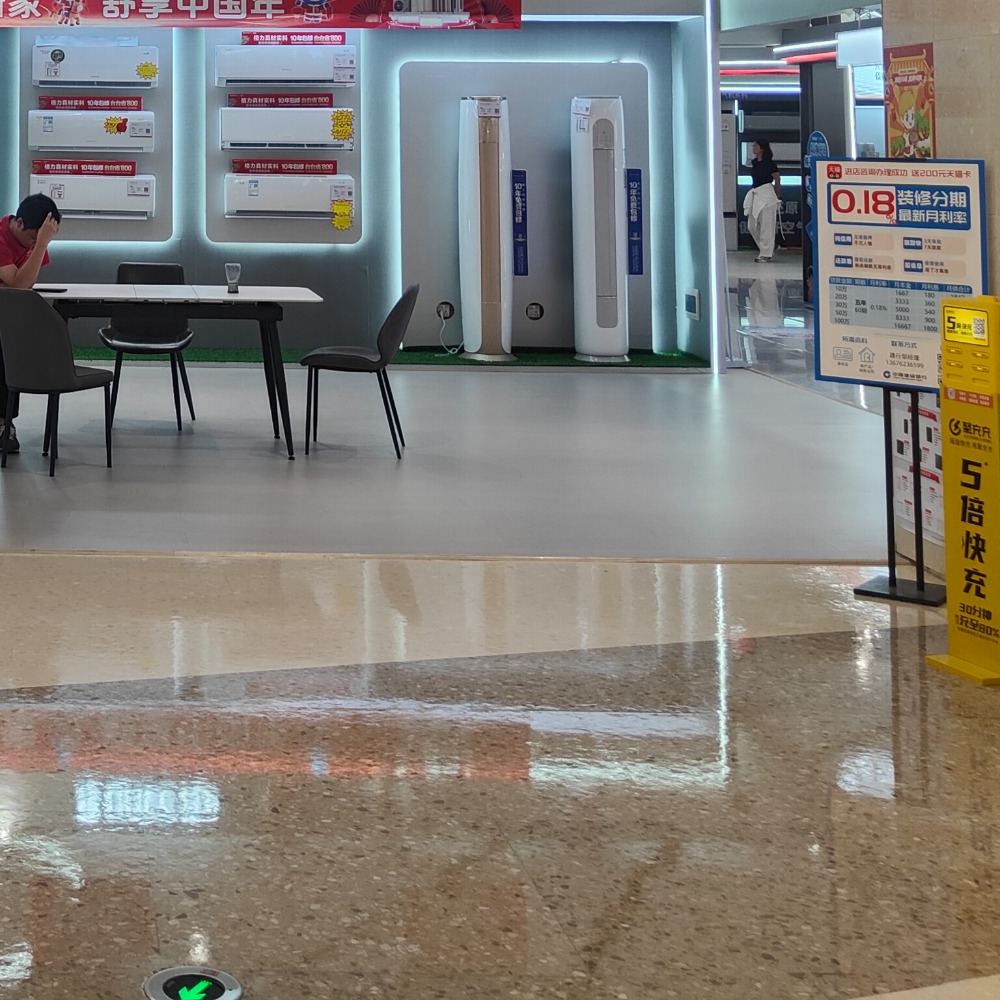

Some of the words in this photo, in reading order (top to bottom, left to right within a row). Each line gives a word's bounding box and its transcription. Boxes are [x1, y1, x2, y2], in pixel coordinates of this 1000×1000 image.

[844, 167, 908, 177] 进店咨询办理成功
[911, 169, 971, 178] 送200元天猫卡
[898, 189, 967, 207] 装修分期
[898, 209, 967, 224] 最新月利率
[960, 458, 987, 599] 5倍快充
[959, 602, 992, 621] 30分钟
